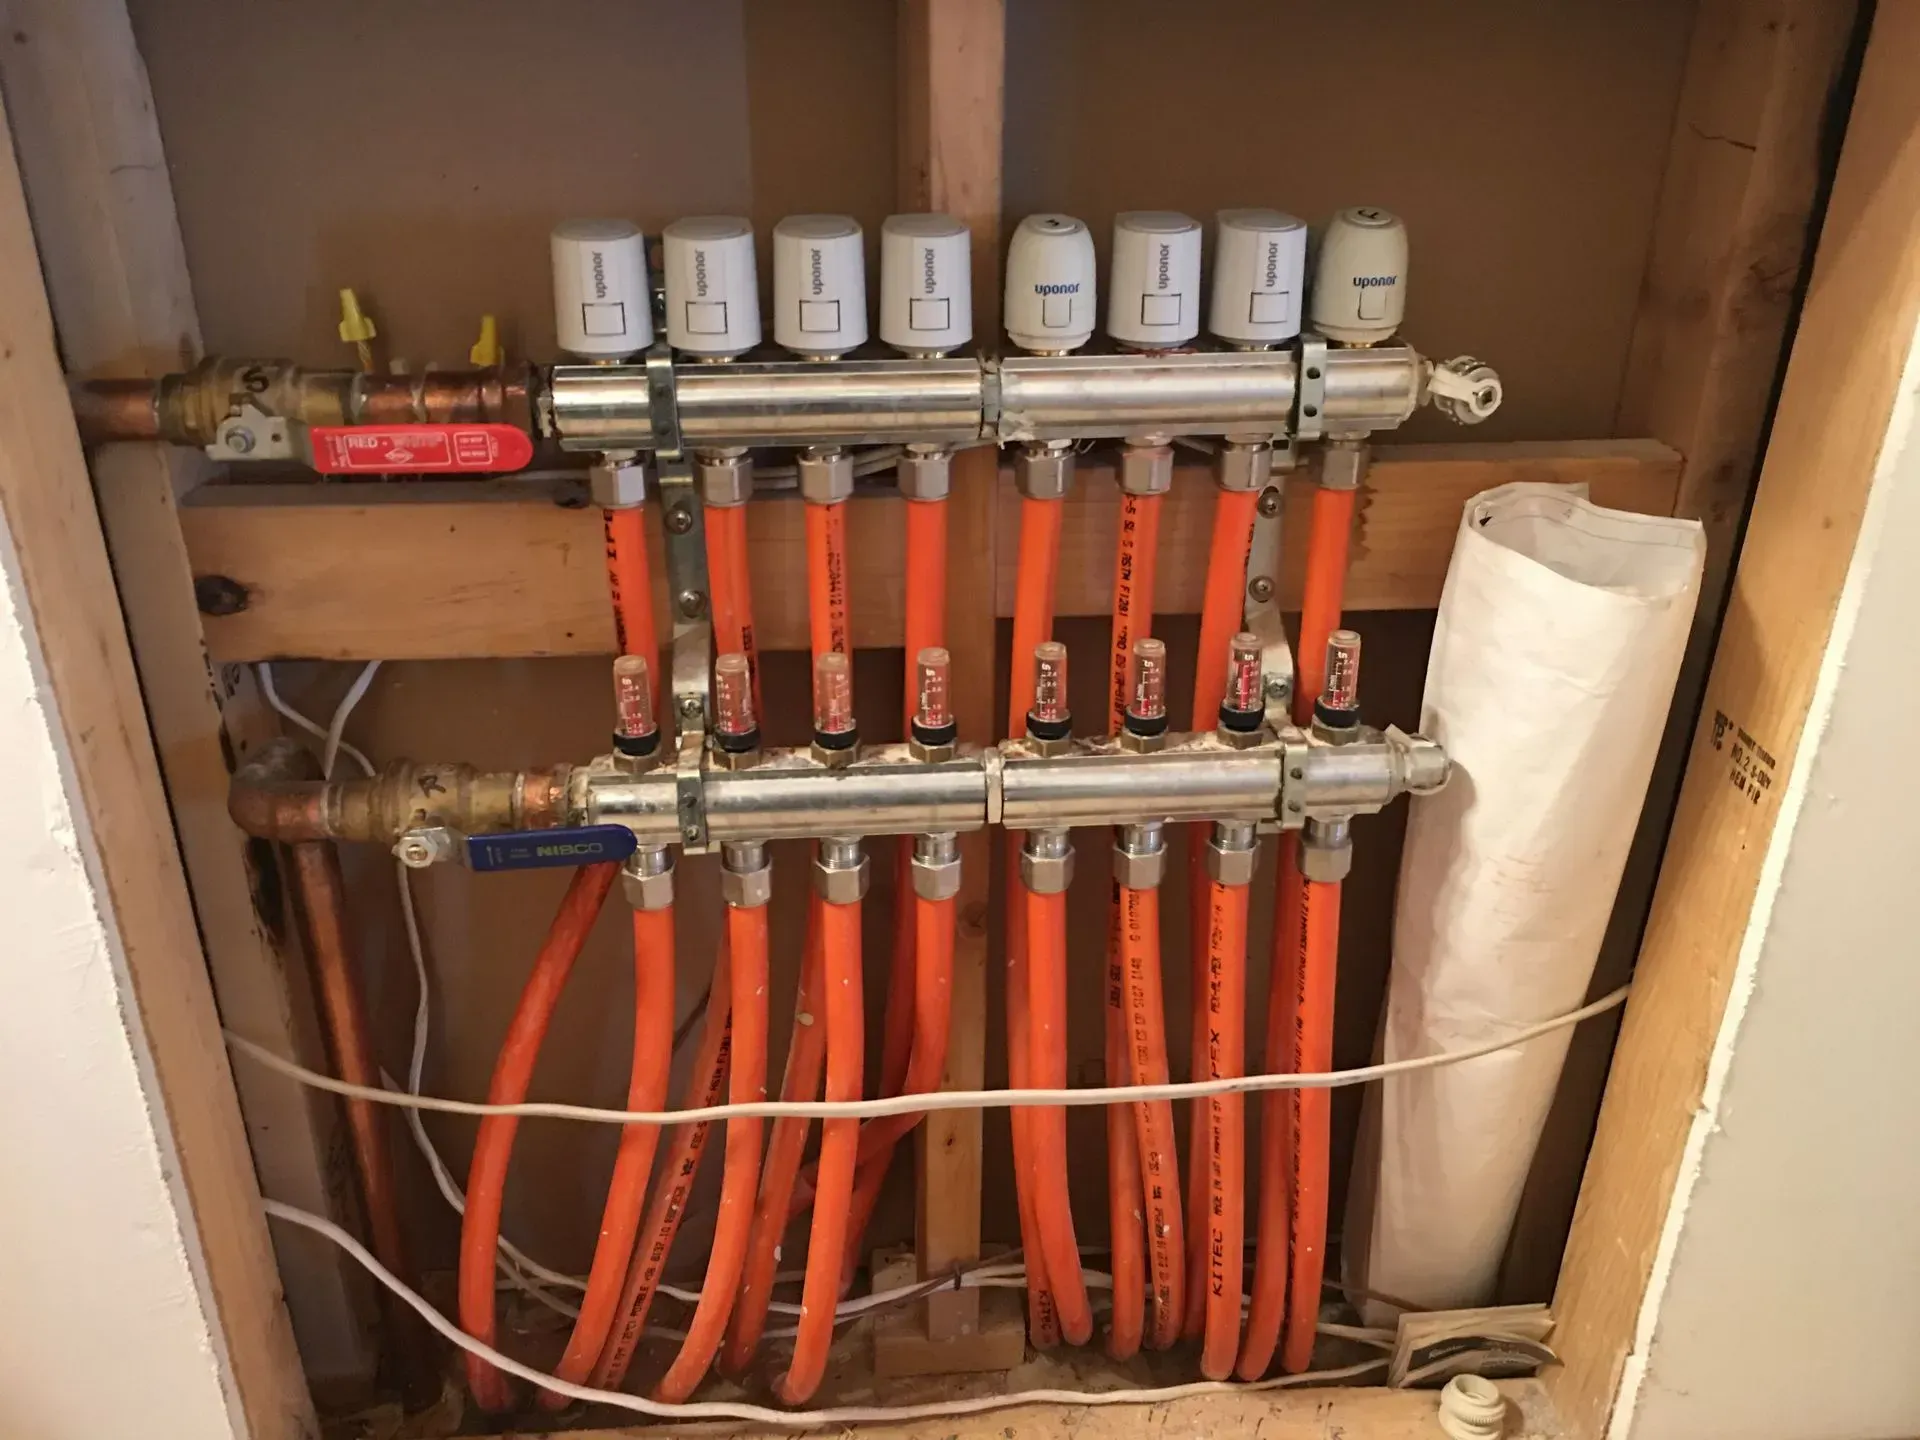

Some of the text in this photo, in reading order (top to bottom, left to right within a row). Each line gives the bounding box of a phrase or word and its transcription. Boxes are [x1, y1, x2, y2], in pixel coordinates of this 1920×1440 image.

[591, 251, 606, 299] uponor
[696, 249, 708, 297] uponor
[812, 248, 823, 296] uponor
[925, 248, 935, 295] uponor
[1158, 243, 1170, 290] uponor
[1267, 241, 1279, 287] uponor
[1353, 274, 1398, 289] uponor
[1034, 282, 1080, 296] uponor
[348, 435, 379, 448] RED
[418, 775, 446, 798] R
[536, 842, 603, 857] NIBCO
[1211, 1228, 1224, 1297] KITEC
